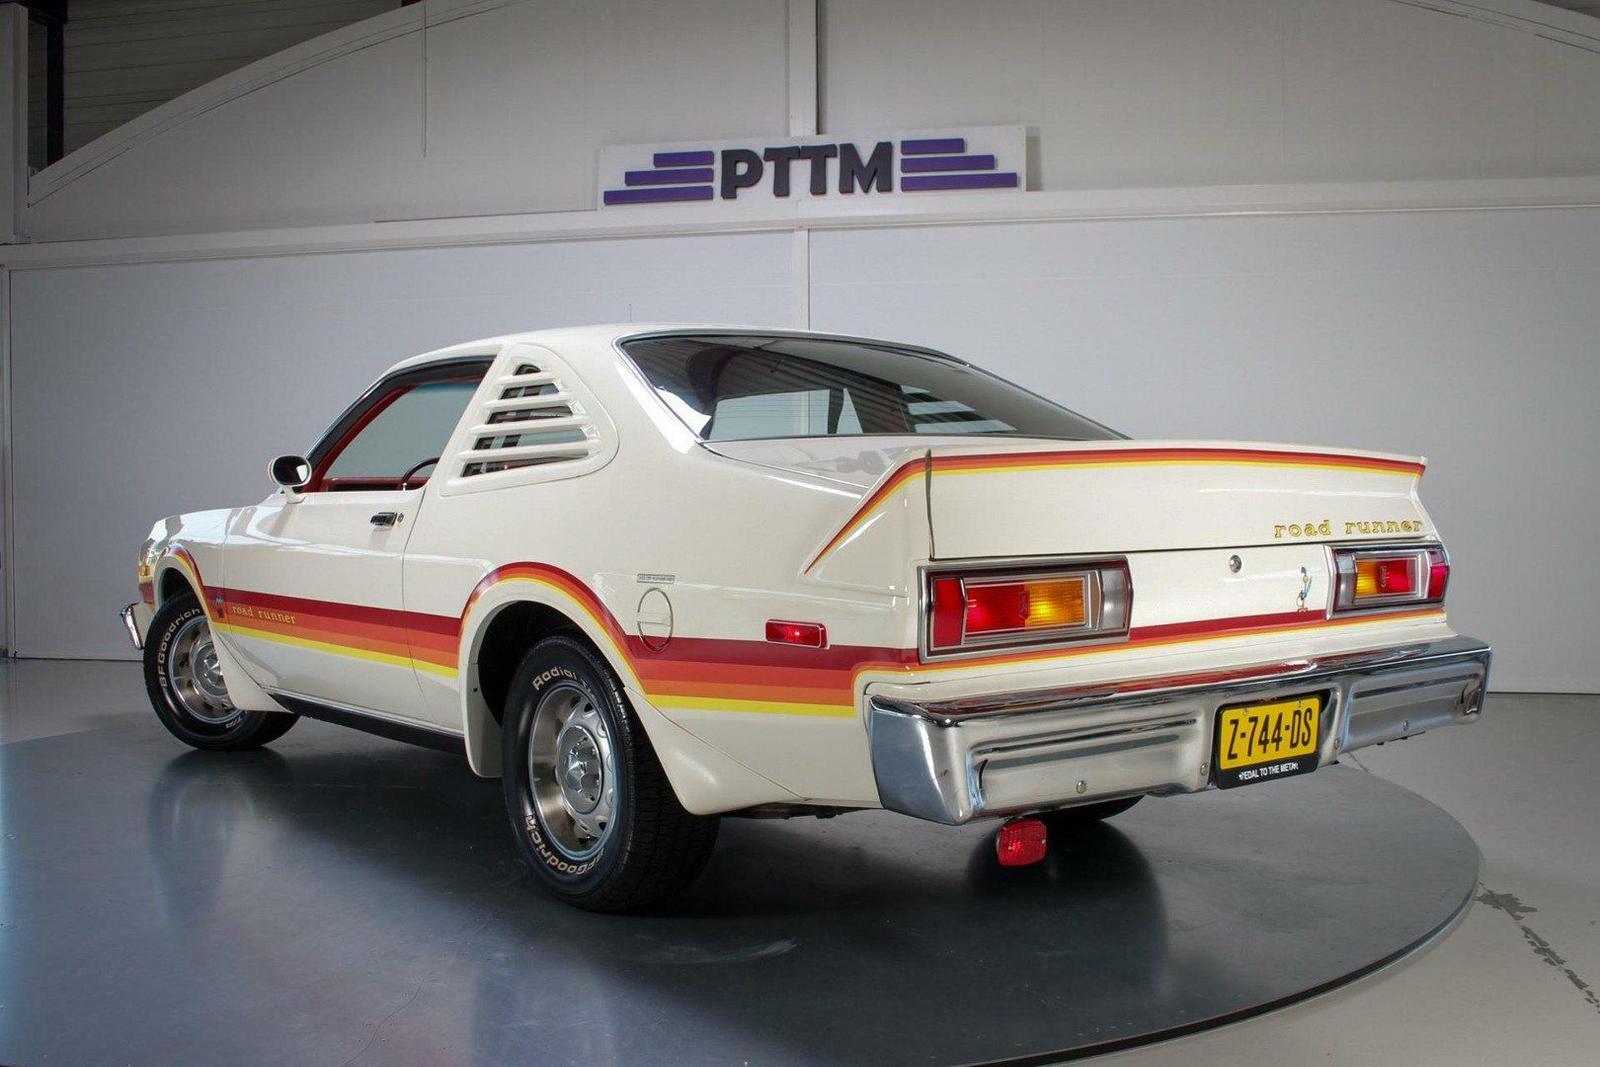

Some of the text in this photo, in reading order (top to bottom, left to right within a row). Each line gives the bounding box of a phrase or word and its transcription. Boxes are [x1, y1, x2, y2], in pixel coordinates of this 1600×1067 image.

[720, 141, 893, 199] PTTM
[1275, 519, 1423, 538] road runner
[232, 606, 297, 624] road runner
[159, 608, 201, 688] BFGoodrich
[531, 665, 578, 691] Radial
[1227, 707, 1313, 760] Z-744-DS
[1259, 767, 1268, 777] TO
[1268, 764, 1280, 775] THE
